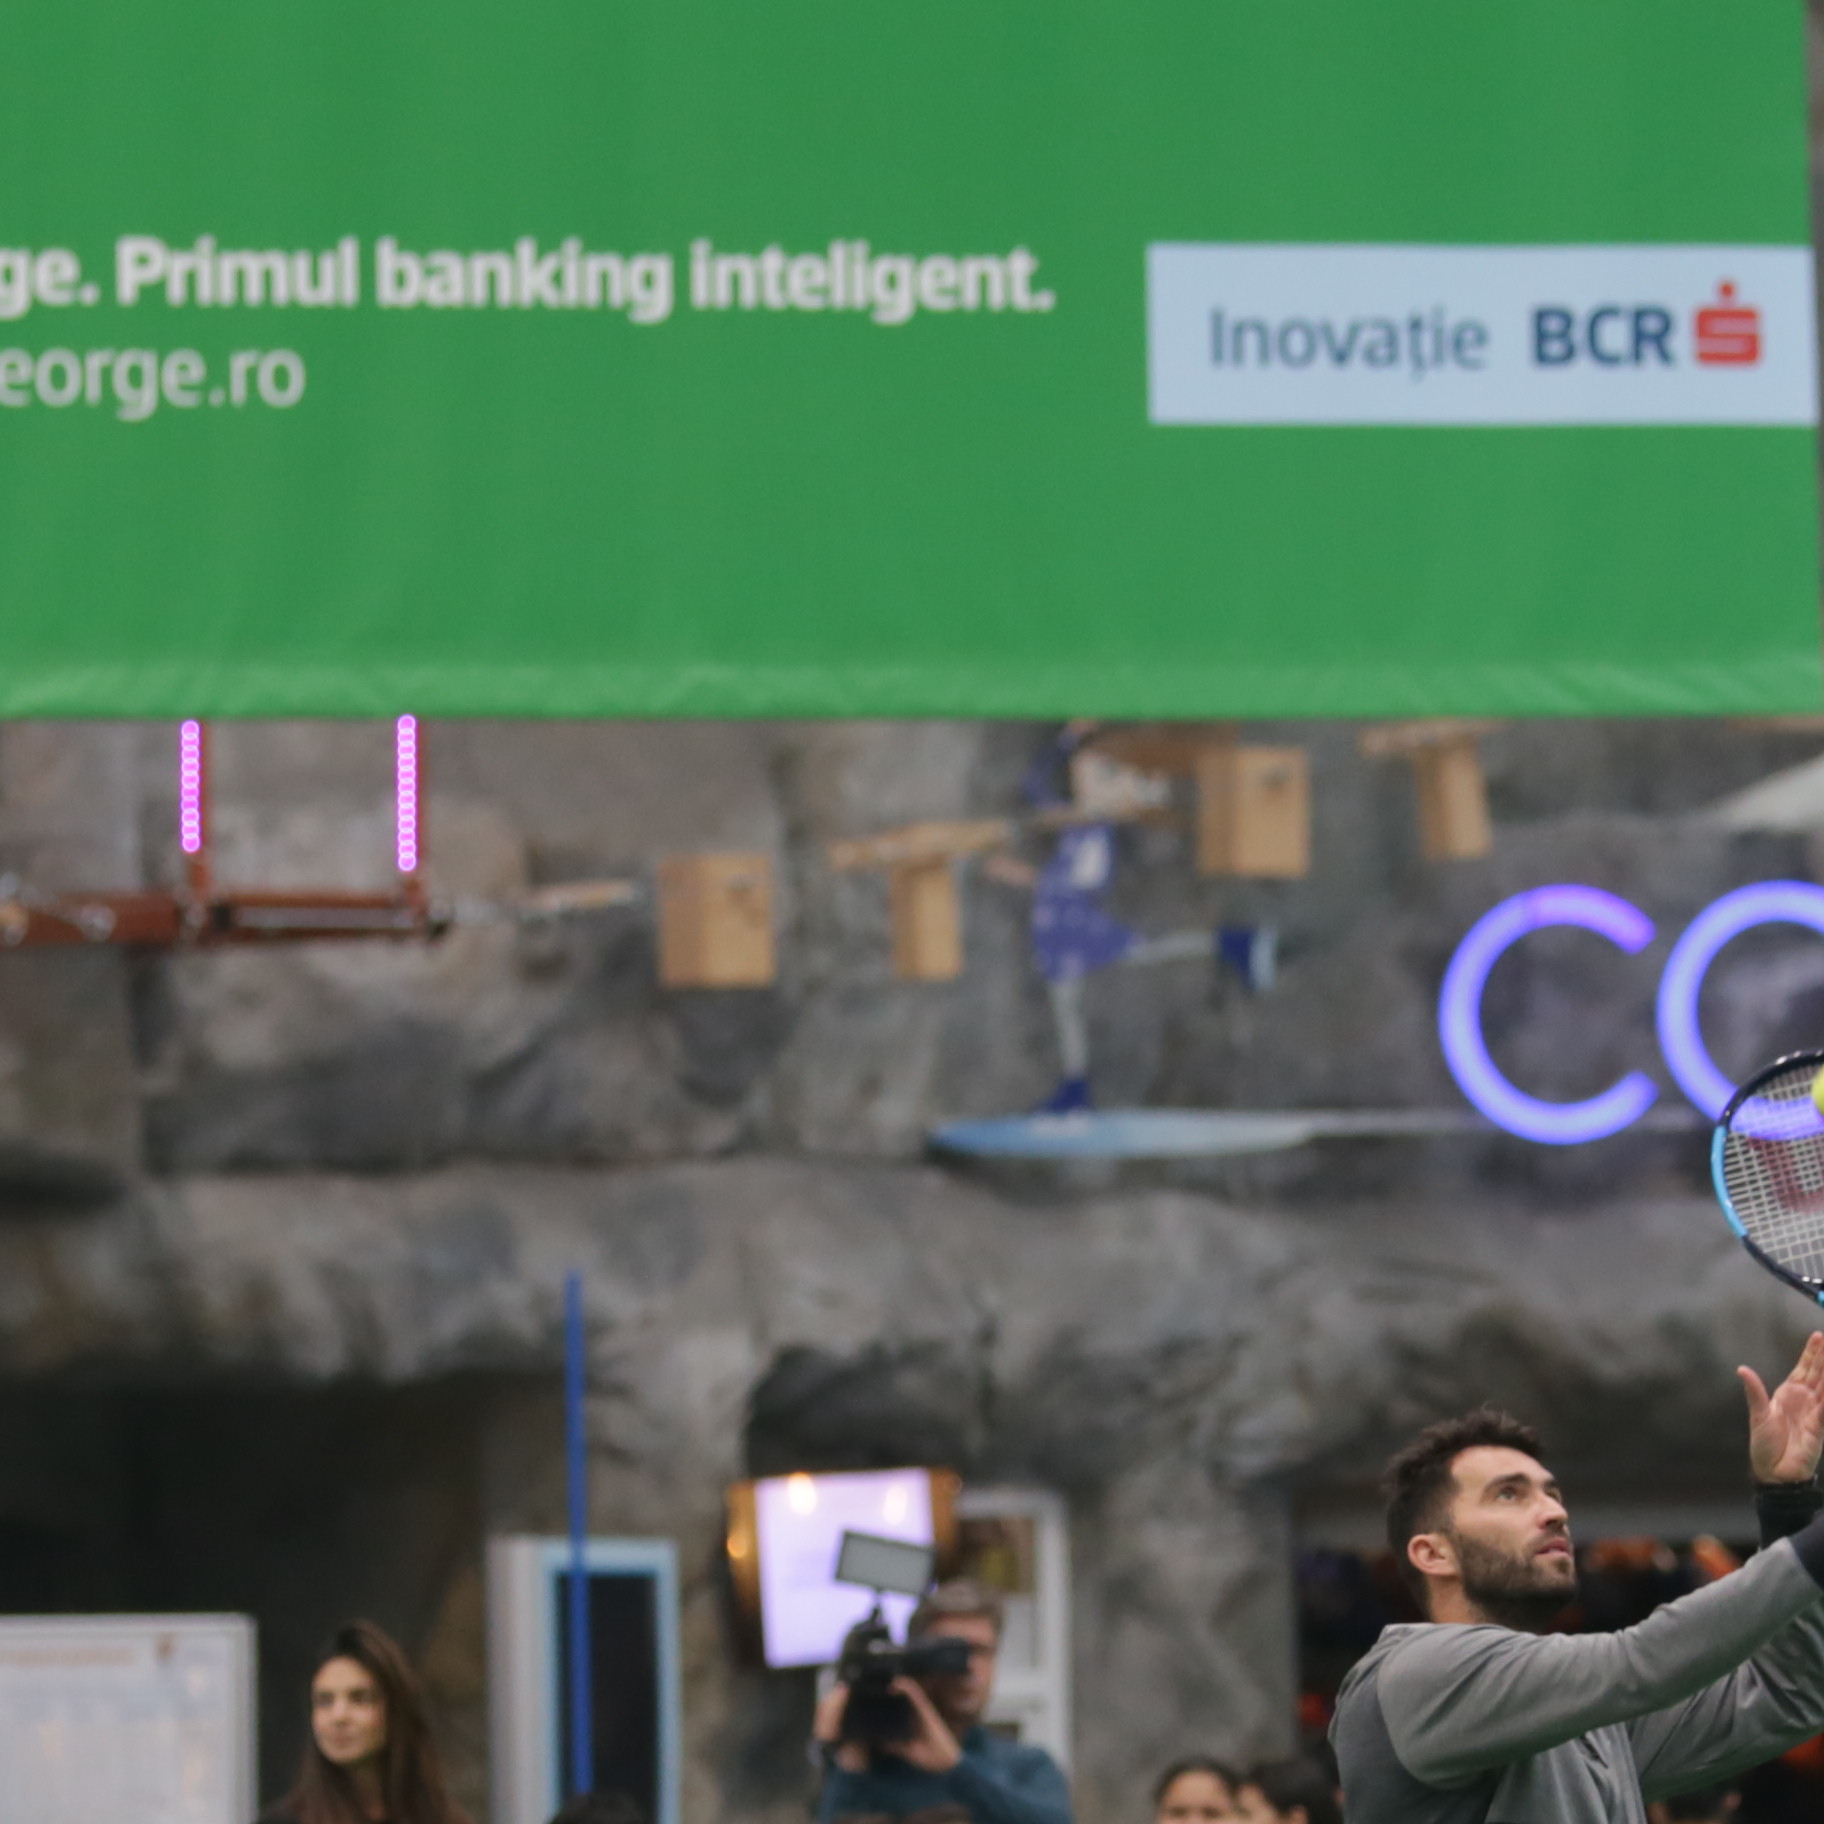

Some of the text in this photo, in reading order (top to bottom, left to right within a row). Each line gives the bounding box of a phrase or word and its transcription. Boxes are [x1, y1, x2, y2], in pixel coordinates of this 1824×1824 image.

[114, 234, 361, 308] Primul
[376, 236, 674, 325] banking
[689, 237, 1057, 326] inteligent.
[1532, 305, 1675, 367] BCR
